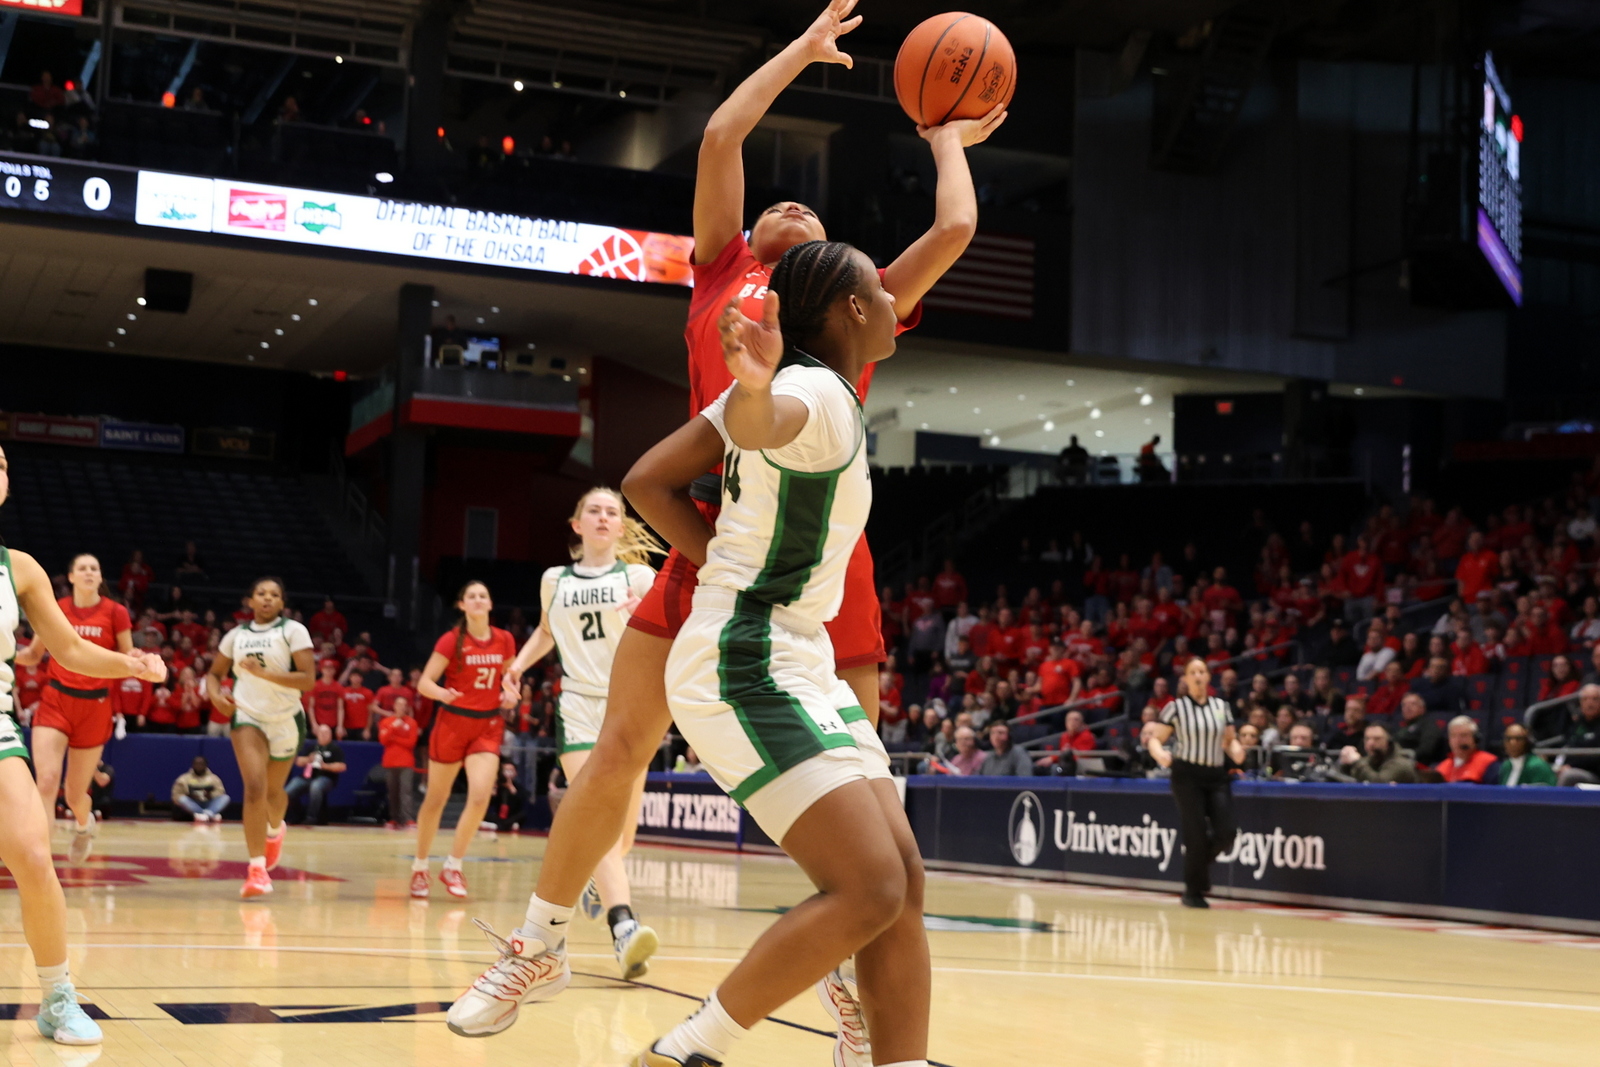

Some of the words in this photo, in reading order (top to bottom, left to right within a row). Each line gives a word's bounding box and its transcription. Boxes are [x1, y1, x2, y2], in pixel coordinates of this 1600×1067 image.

[950, 54, 970, 84] NFHS
[5, 176, 21, 198] 0
[34, 180, 50, 201] 5
[83, 177, 112, 211] 0
[377, 200, 456, 229] OFFICIAL
[466, 211, 579, 243] BASKETBALL
[413, 232, 434, 251] OF
[445, 236, 474, 257] THE
[484, 240, 545, 264] OHSAA
[105, 428, 140, 441] SAINT
[145, 431, 181, 444] LOUIS
[564, 587, 617, 607] LAUREL
[579, 611, 606, 641] 21
[239, 638, 272, 649] LAUREL
[474, 667, 496, 689] 21
[672, 793, 741, 833] FLYERS
[1053, 809, 1178, 872] University
